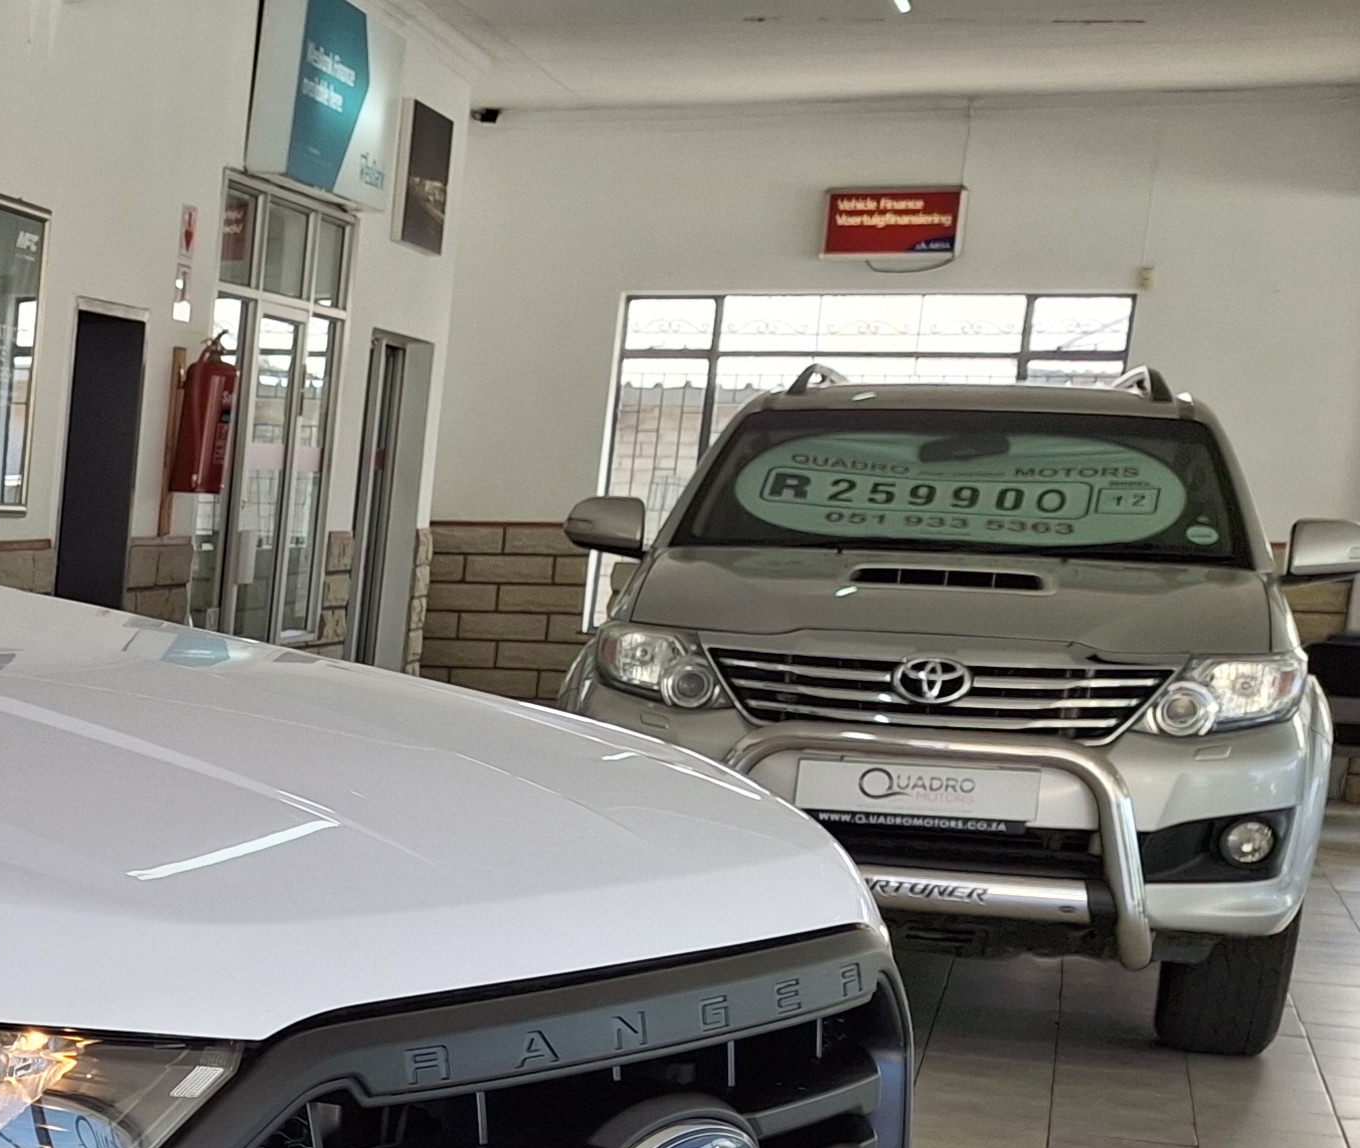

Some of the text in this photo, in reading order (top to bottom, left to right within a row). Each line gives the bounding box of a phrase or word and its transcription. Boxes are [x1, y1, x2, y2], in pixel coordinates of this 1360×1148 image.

[837, 196, 925, 211] Vehicle Finance
[791, 454, 911, 475] QUADRO
[1014, 466, 1141, 478] MOTORS
[768, 472, 1067, 513] R 259900
[824, 511, 887, 525] 051
[903, 515, 969, 529] 933
[985, 519, 1075, 535] 5363
[858, 767, 976, 800] QUADRO
[915, 792, 975, 804] MOTORS
[818, 811, 1008, 833] WWW.QUADROMOTORS.CO.ZA
[404, 962, 864, 1085] RANGER
